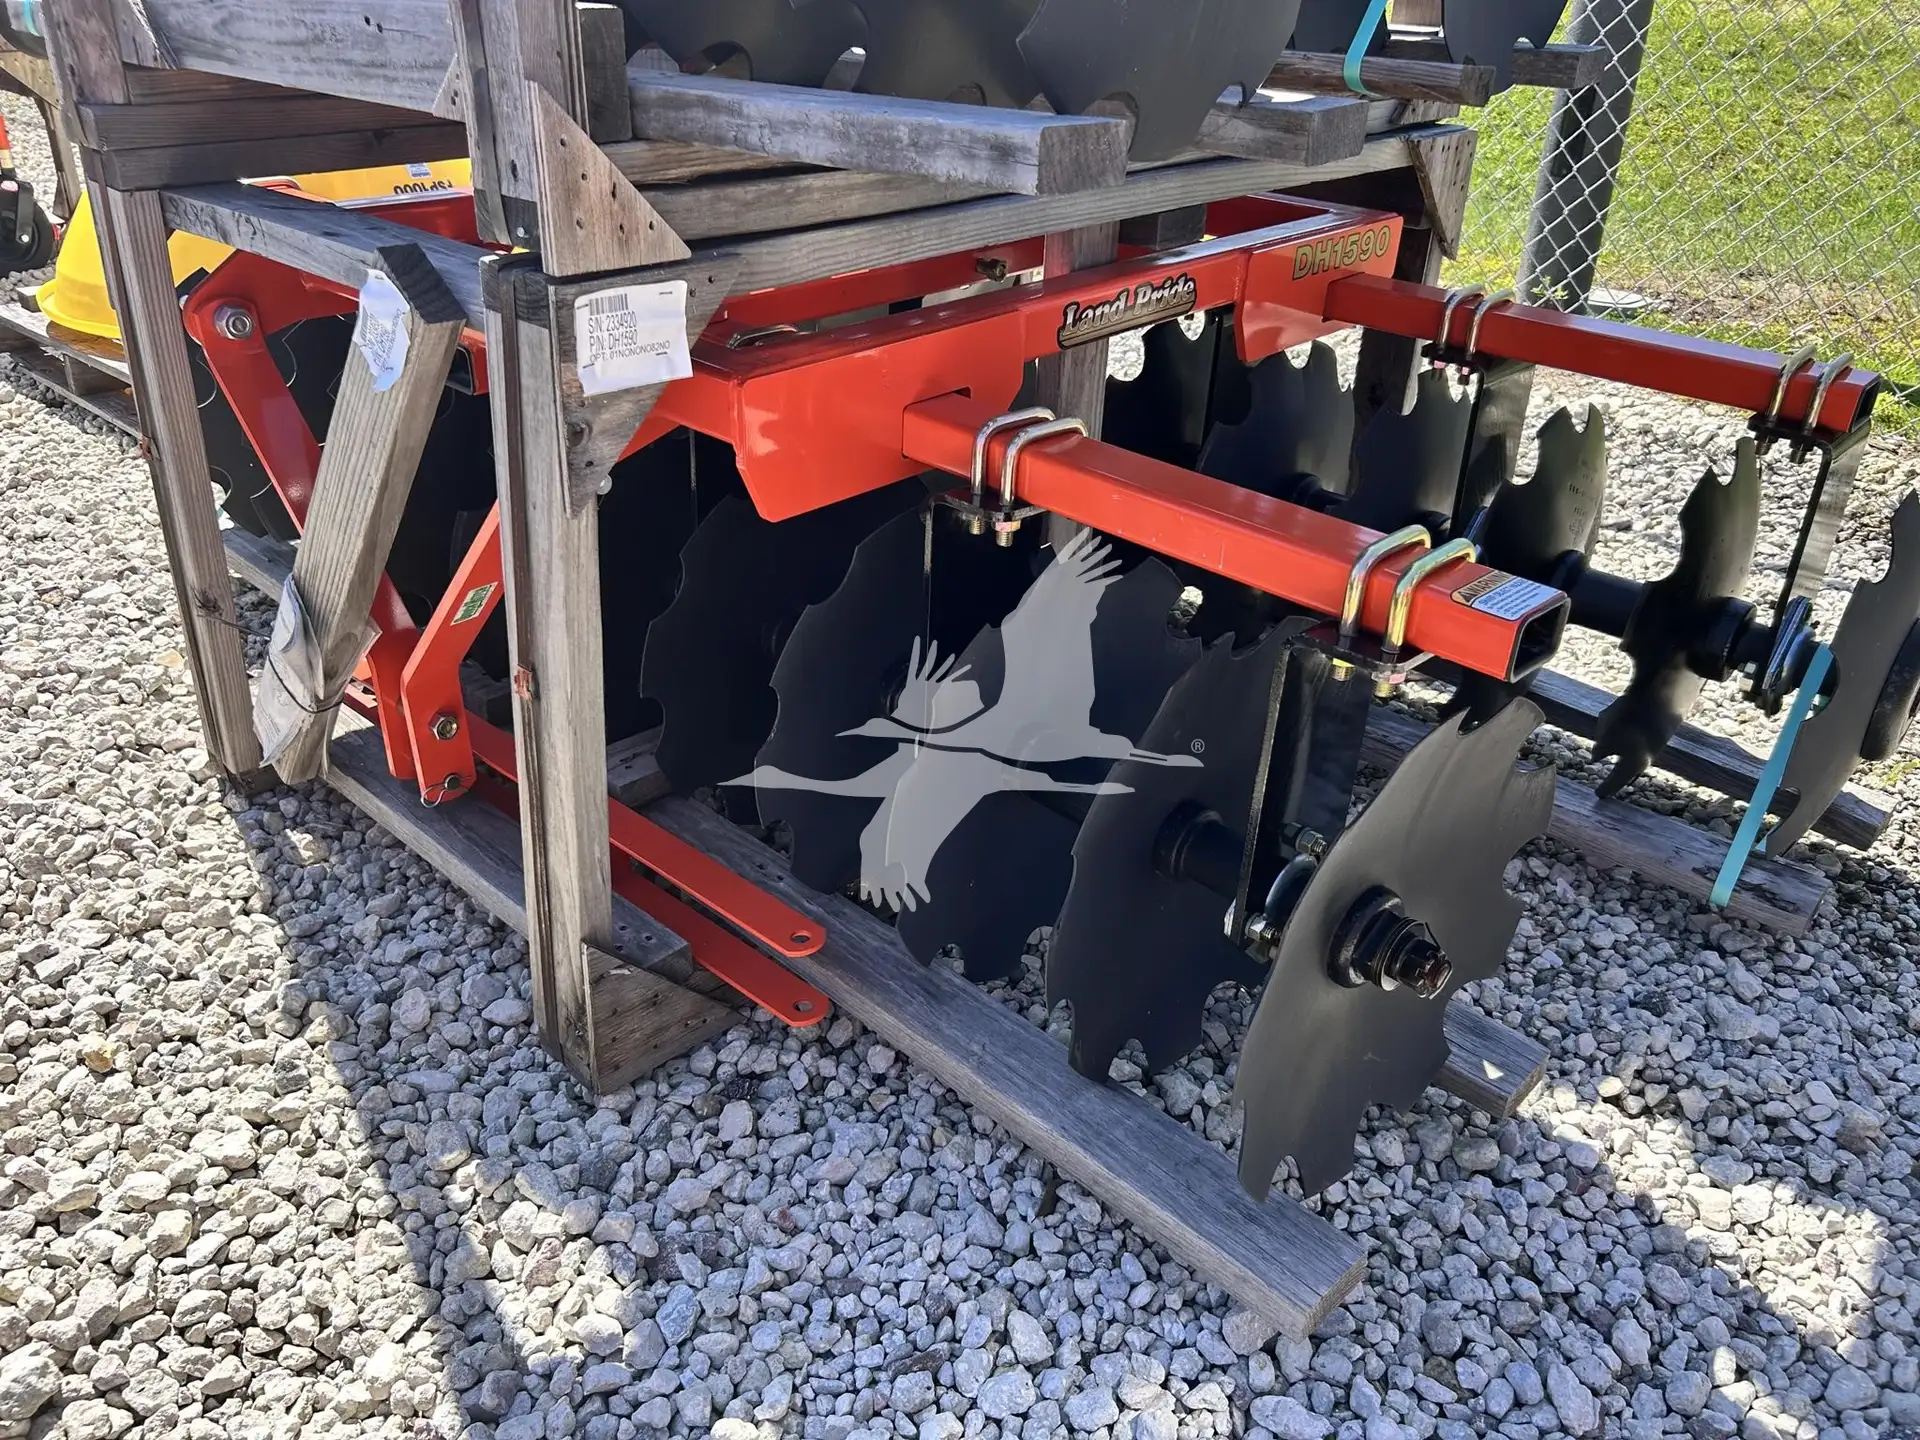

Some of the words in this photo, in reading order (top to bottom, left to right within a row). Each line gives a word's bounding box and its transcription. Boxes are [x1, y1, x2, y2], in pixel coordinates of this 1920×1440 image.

[1292, 225, 1391, 280] DH1590
[1062, 288, 1129, 337] Land
[1132, 273, 1196, 317] Pride
[588, 317, 604, 334] S/N:
[606, 311, 637, 332] 2334920
[589, 335, 606, 353] P/N:
[608, 329, 638, 350] DH1590
[589, 352, 608, 364] OPT:
